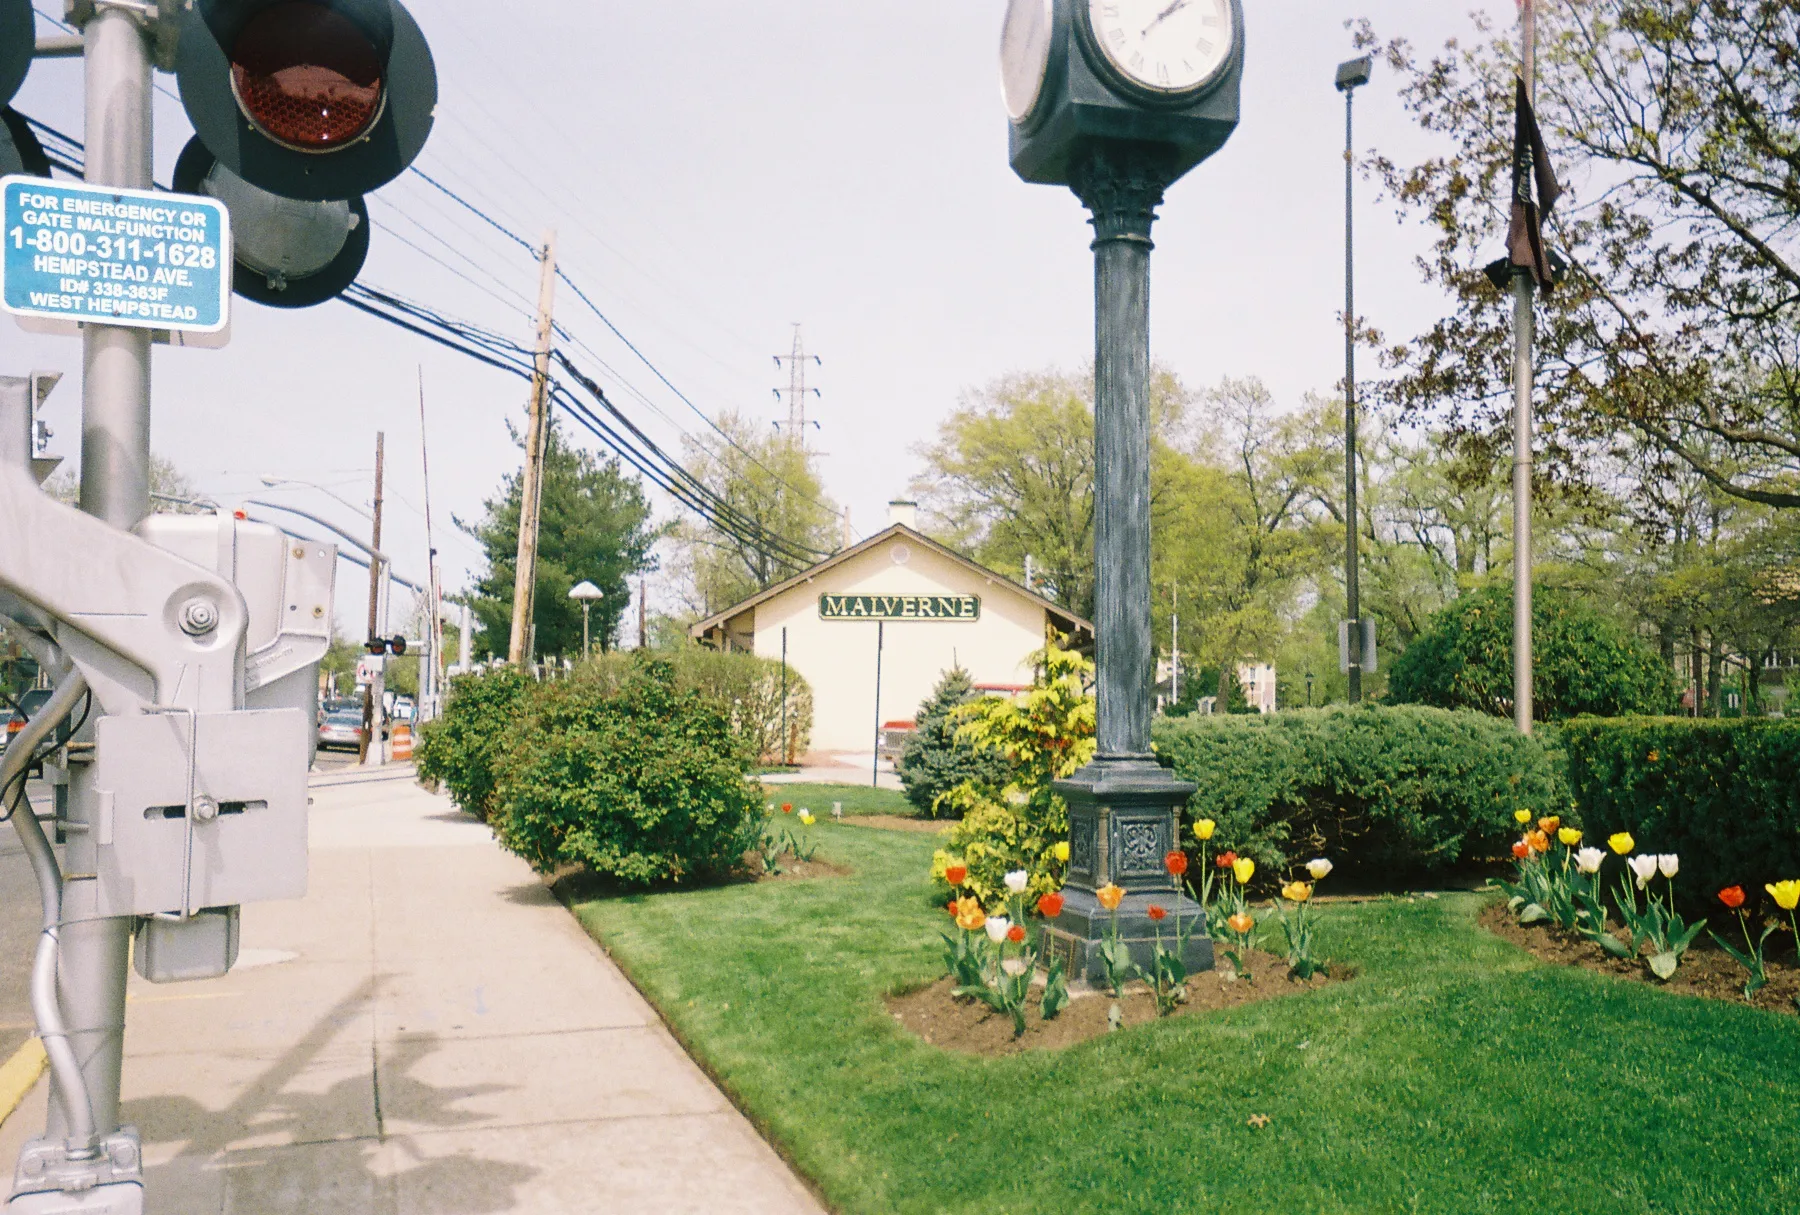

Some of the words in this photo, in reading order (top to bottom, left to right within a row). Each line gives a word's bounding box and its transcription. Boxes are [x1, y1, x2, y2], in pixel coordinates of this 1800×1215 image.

[19, 192, 59, 210] FOR
[63, 196, 177, 221] EMERGENCY
[180, 211, 207, 227] OR
[22, 210, 73, 229] GATE
[77, 216, 205, 243] MALFUNCTION
[9, 226, 217, 269] 1-800-311-1628
[34, 255, 150, 282] HEMPSTEAD
[153, 267, 193, 287] AVE.
[60, 278, 90, 293] ID#
[93, 281, 169, 300] 338-363F
[30, 291, 84, 310] WEST
[88, 297, 198, 320] HEMPSTEAD
[825, 596, 975, 617] MALVERNE
